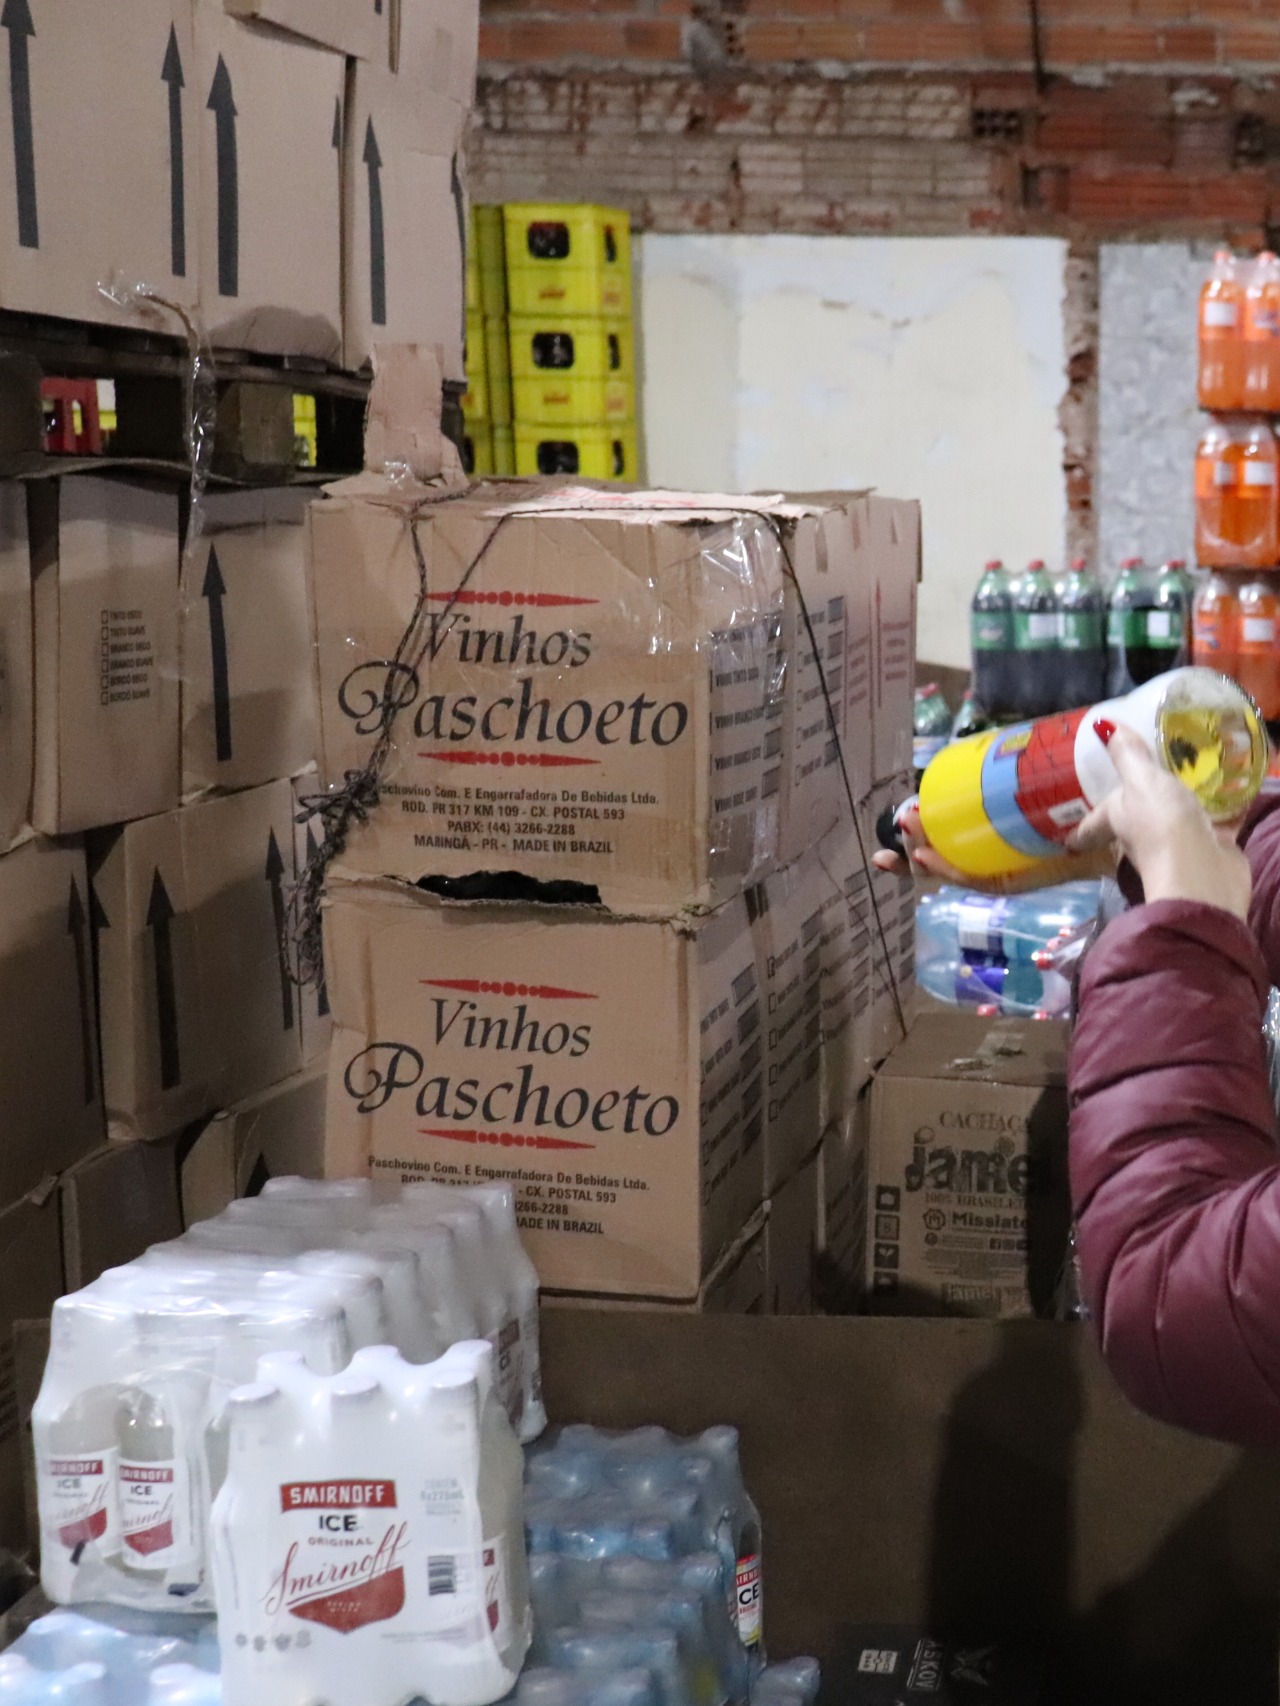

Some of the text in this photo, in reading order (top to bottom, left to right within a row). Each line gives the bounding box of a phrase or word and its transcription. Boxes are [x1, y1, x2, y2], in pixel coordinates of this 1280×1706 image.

[425, 612, 592, 667] Vinhos
[339, 661, 688, 746] Paschoeto
[381, 783, 660, 804] schovino Com. E Engarrafadora De Bebidas Ltda.
[402, 801, 429, 814] ROD.
[432, 803, 446, 815] PR
[449, 803, 470, 816] 317
[474, 805, 494, 816] KM
[498, 805, 519, 817] 109
[530, 805, 549, 818] CX.
[553, 806, 600, 820] POSTAL
[603, 808, 625, 820] 593
[447, 820, 576, 836] PABX: (44) 3266-2288
[482, 838, 499, 850] PR
[512, 839, 550, 852] MADE
[553, 841, 566, 853] IN
[570, 841, 614, 854] BRAZIL
[430, 997, 592, 1058] Vinhos
[344, 1041, 680, 1136] Paschoeto
[367, 1155, 650, 1191] Paschovino Com. E Engarrafadora De Bebidas Ltda.
[526, 1185, 545, 1198] CX.
[548, 1187, 593, 1202] POSTAL
[596, 1191, 617, 1203] 593
[547, 1218, 560, 1231] IN
[563, 1219, 605, 1235] BRAZIL
[130, 1484, 152, 1496] ICE
[289, 1484, 386, 1506] SMIRNOFF
[318, 1513, 358, 1532] ICE
[308, 1535, 374, 1548] ORIGINAL
[259, 1519, 413, 1616] Smirnoff
[738, 1582, 760, 1605] CE
